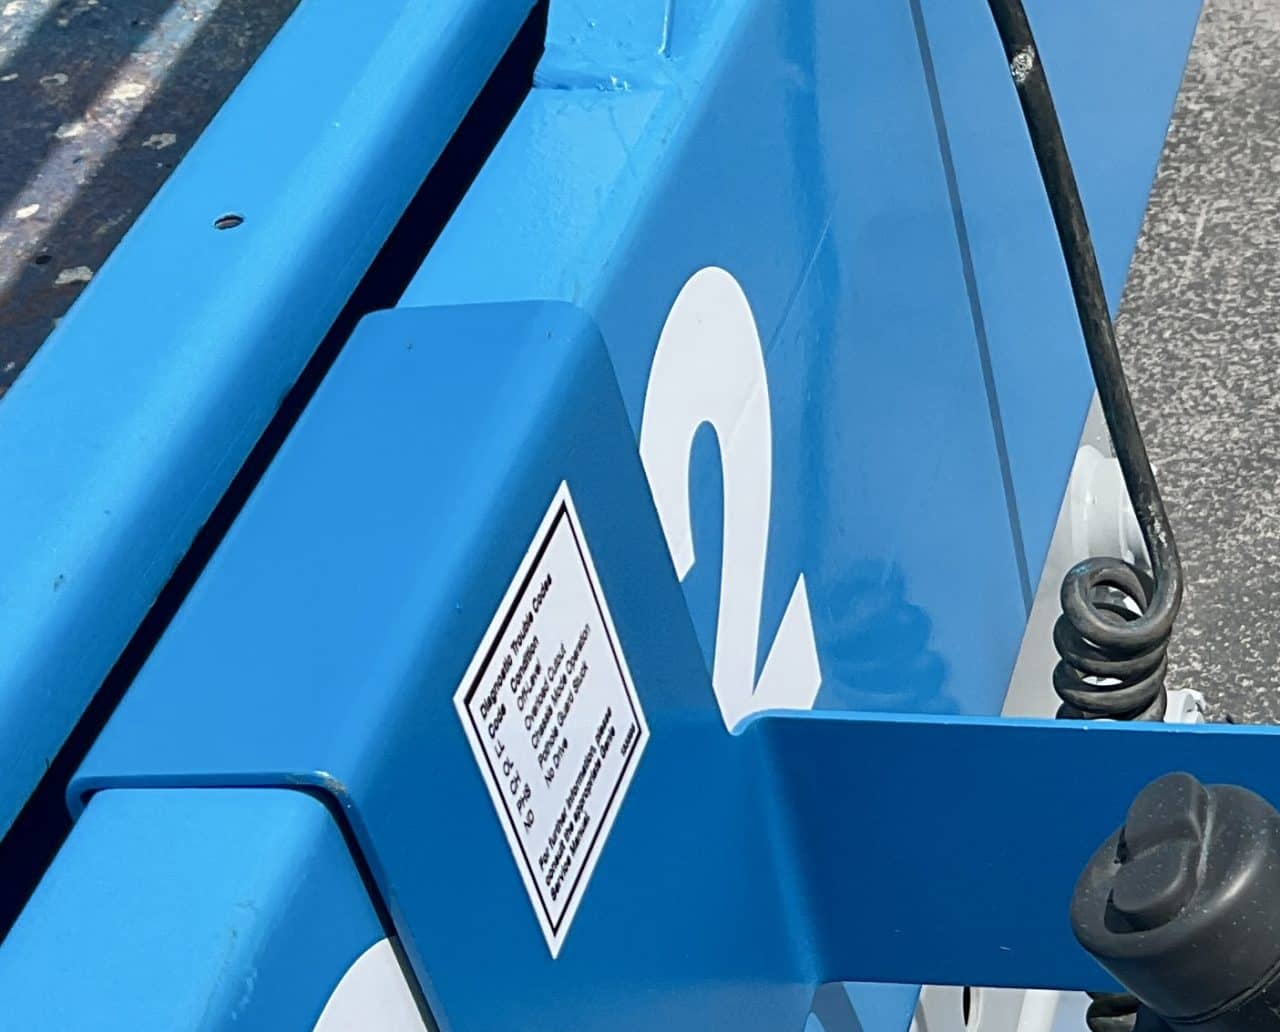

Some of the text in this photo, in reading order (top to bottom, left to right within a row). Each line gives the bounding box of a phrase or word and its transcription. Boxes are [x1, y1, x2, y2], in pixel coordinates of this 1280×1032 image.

[478, 572, 554, 722] Diagnostic Trouble Codes
[486, 634, 540, 741] Code Condition
[501, 642, 568, 778] OL Overload Cutout
[508, 622, 591, 797] CH Chassis Mode Operation
[515, 660, 590, 816] PHS Pothole Guard Stuck
[522, 736, 570, 833] ND No Drive
[562, 820, 576, 844] the
[598, 724, 617, 761] Genie
[537, 846, 551, 873] For
[547, 806, 569, 851] further
